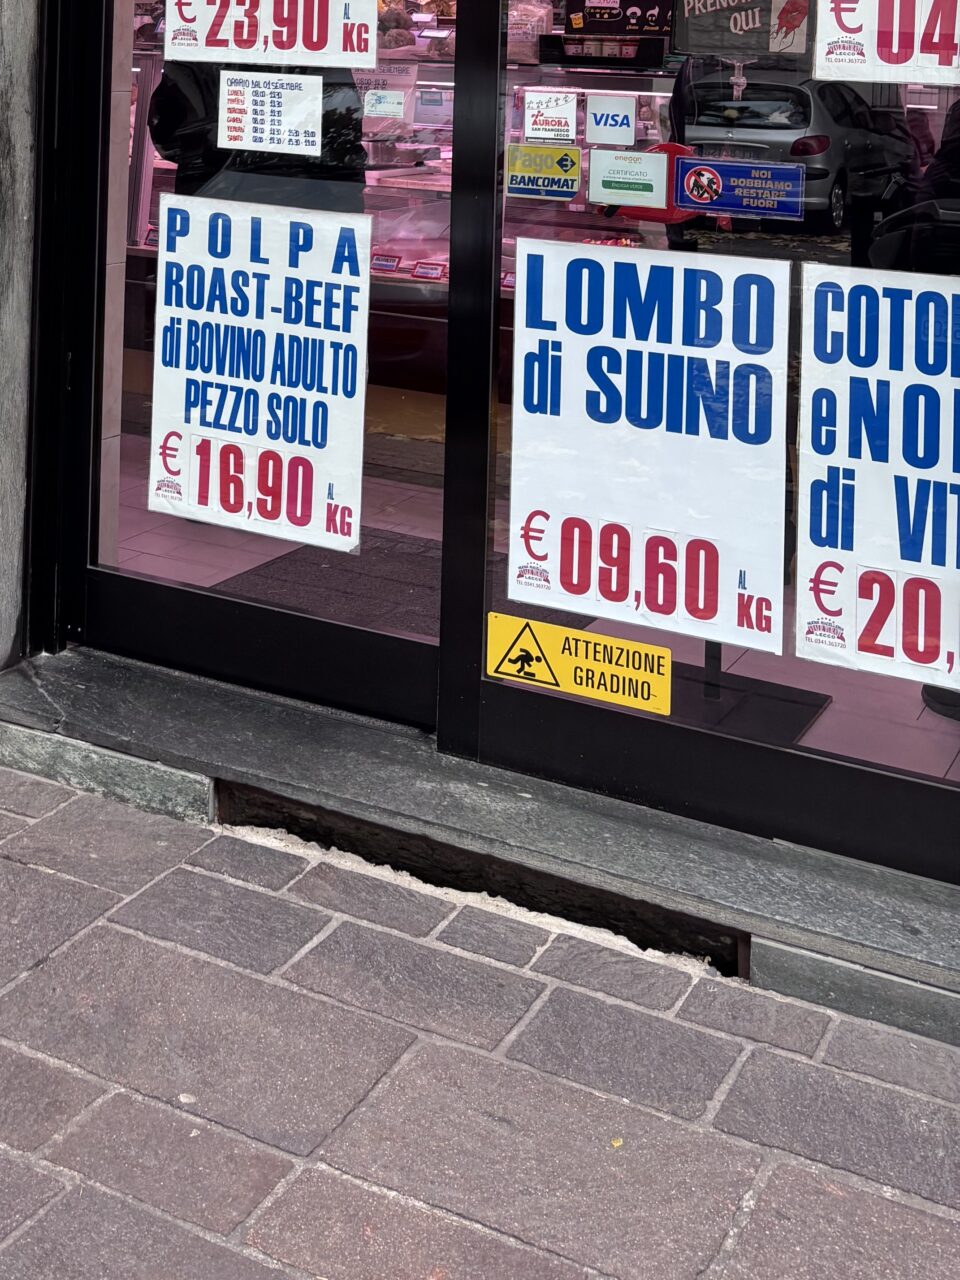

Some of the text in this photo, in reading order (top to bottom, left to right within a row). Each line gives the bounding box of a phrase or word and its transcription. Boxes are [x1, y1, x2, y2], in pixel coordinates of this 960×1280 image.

[342, 22, 369, 53] KG
[730, 8, 761, 35] QUI
[227, 78, 249, 88] ORARIO
[251, 80, 262, 88] DAL
[532, 119, 569, 127] AURORA
[591, 113, 630, 128] VISA
[510, 174, 577, 190] BANCOMAT
[608, 169, 647, 177] CERTIFICATO
[730, 178, 792, 190] DOBBIAMO
[751, 170, 771, 178] NOI
[735, 187, 786, 199] RESTARE
[743, 199, 777, 208] FUORI
[166, 207, 360, 277] POLPA
[163, 261, 360, 333] ROAST-BEEF
[525, 253, 775, 355] LOMBO
[161, 317, 357, 398] di BOVINO ADULTO
[523, 339, 773, 445] di SUINO
[184, 379, 329, 450] PEZZO SOLO
[848, 376, 960, 474] NO
[158, 431, 183, 476] €
[195, 438, 314, 527] 16,90
[325, 503, 352, 538] KG
[809, 465, 855, 551] di
[520, 509, 551, 561] €
[559, 516, 719, 621] 09,60
[808, 561, 844, 617] €
[737, 593, 772, 634] KG
[561, 635, 666, 676] ATTENZIONE
[573, 666, 652, 701] GRADINO
